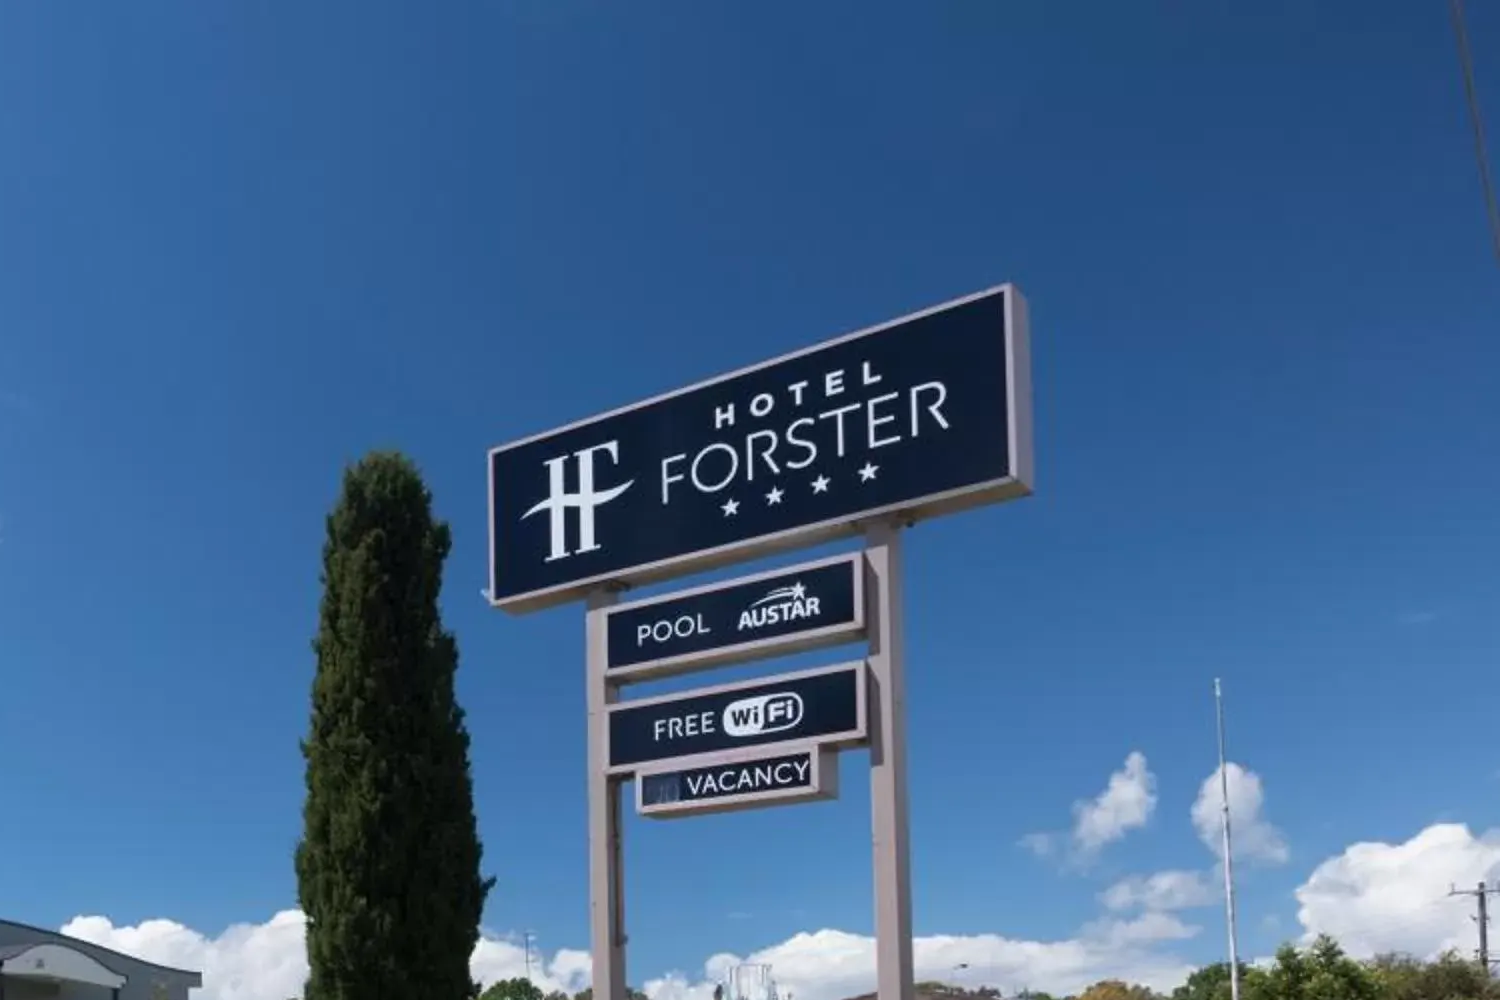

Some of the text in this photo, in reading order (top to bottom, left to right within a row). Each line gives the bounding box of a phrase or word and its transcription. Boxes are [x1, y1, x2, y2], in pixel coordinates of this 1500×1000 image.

[714, 361, 882, 429] HOTEL
[661, 381, 950, 505] FORSTER
[636, 597, 821, 647] POOL AUSTAR
[654, 698, 795, 741] FREE WiFi
[687, 760, 809, 796] VACANCY
